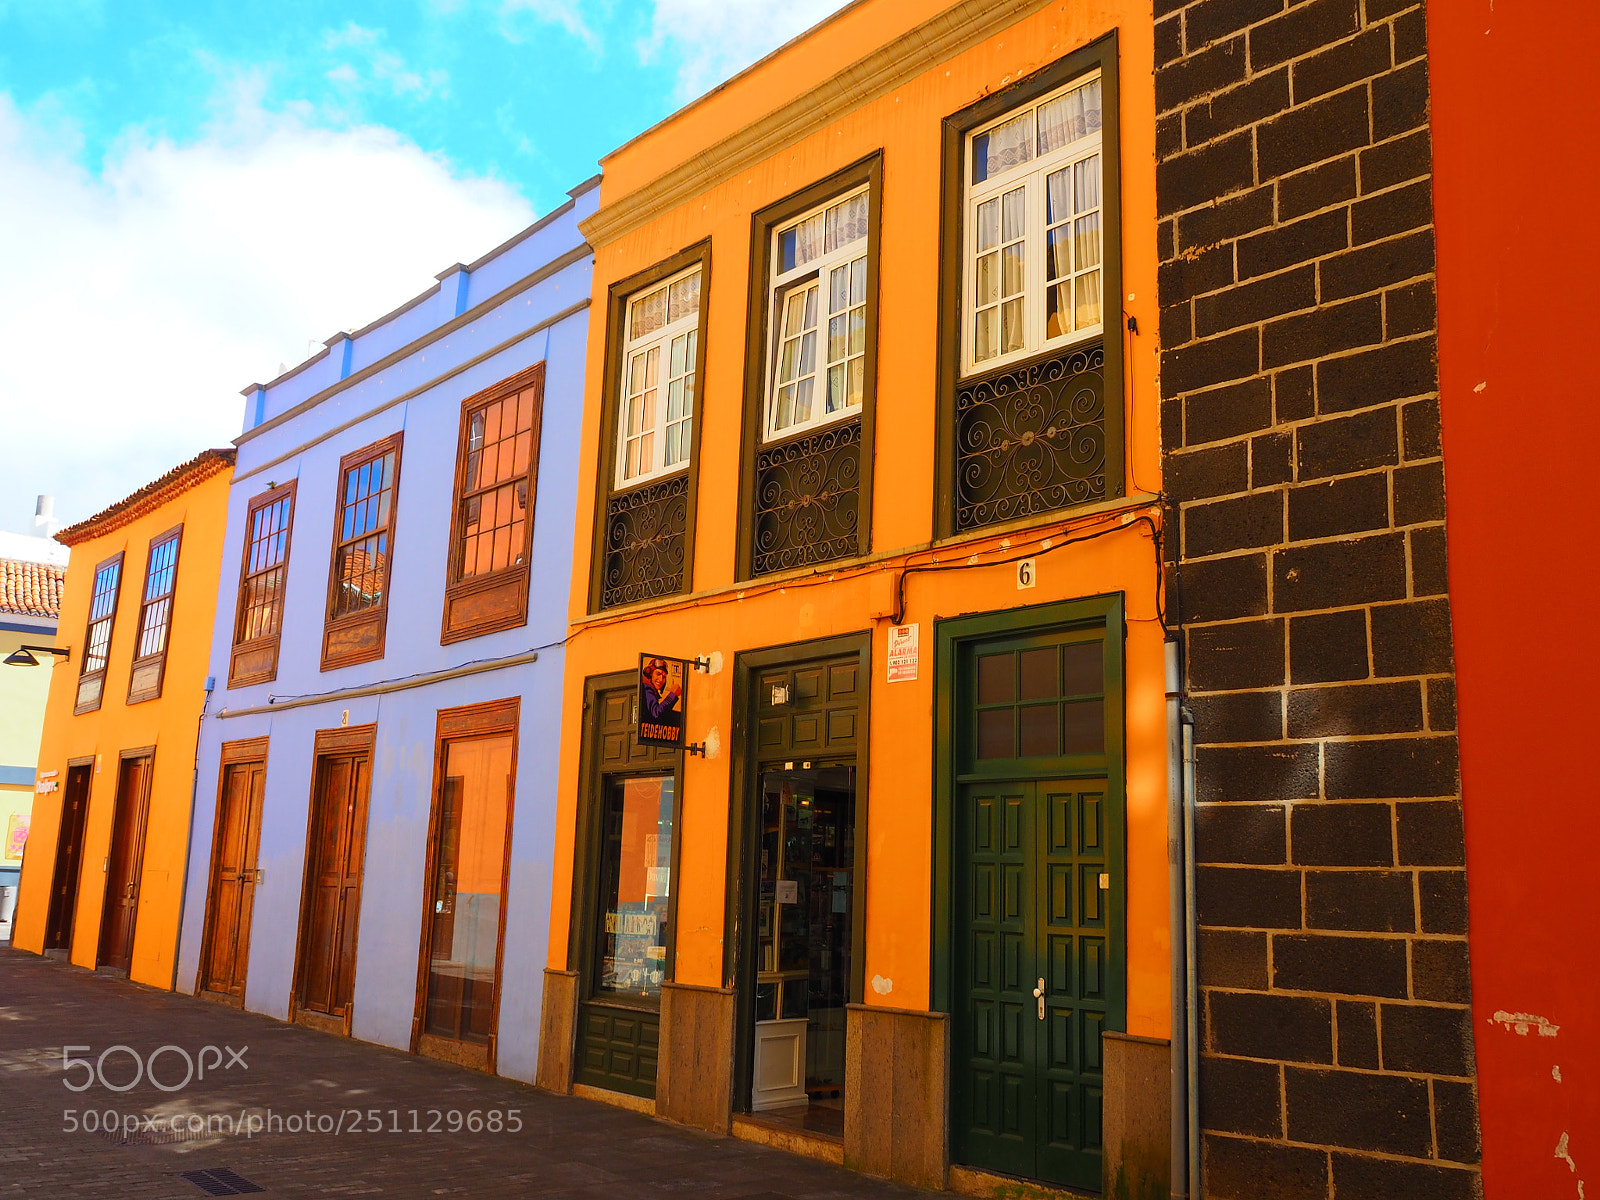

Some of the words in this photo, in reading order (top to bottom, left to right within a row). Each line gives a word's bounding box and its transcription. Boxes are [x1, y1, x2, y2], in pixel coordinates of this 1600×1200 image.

[1019, 562, 1030, 585] 6
[889, 646, 917, 657] ALARMA
[641, 722, 680, 741] TEIDEHOBBY
